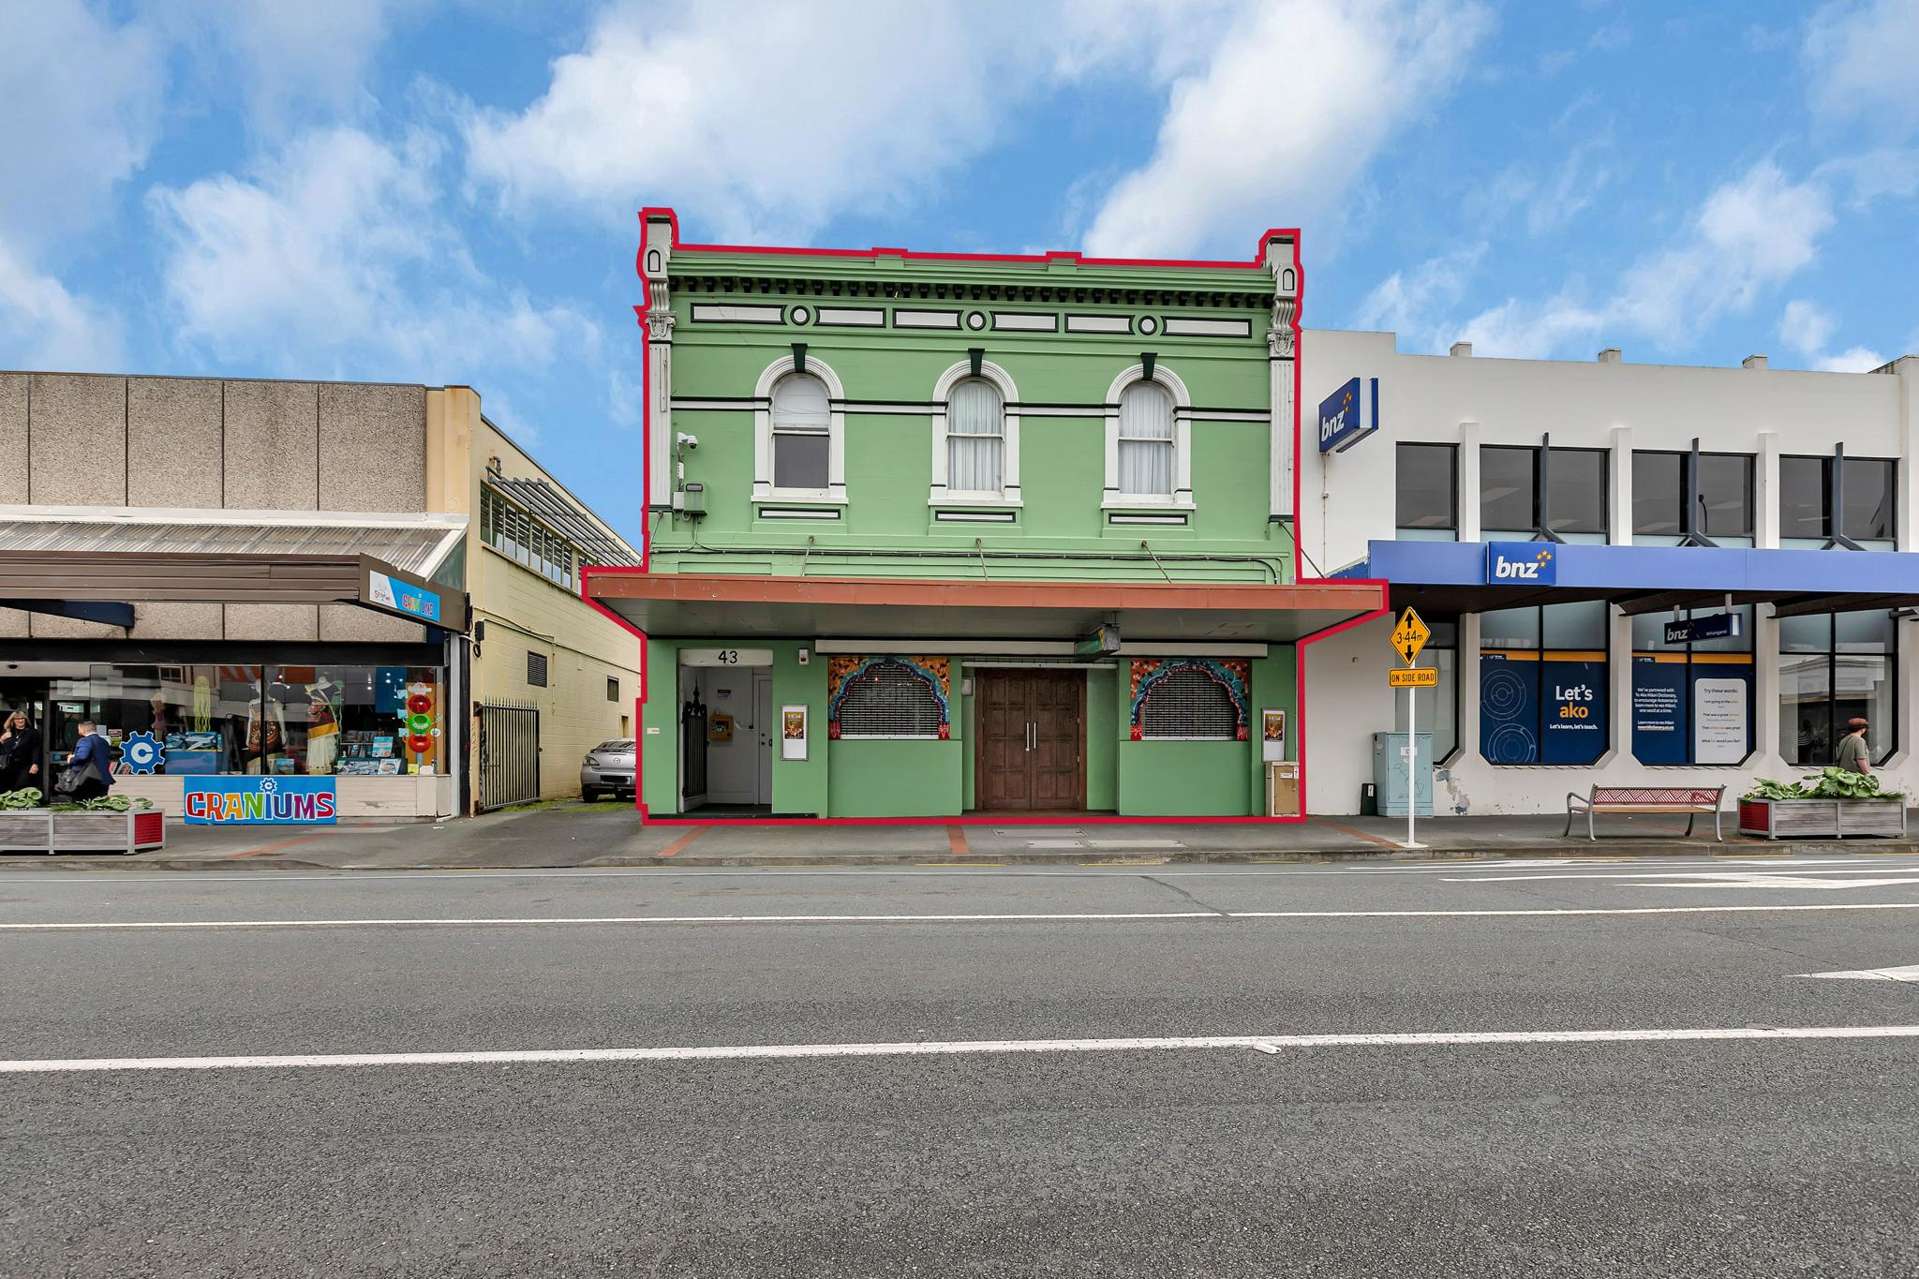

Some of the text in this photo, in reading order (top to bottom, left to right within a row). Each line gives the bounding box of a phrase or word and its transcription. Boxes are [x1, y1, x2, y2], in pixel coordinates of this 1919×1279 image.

[1321, 410, 1345, 442] bnz
[1496, 555, 1539, 578] bnz
[1667, 628, 1688, 641] bnz
[718, 650, 738, 664] 43
[1391, 672, 1435, 683] ON SIDE ROAD
[1555, 684, 1593, 701] Let's
[1559, 702, 1589, 719] ako
[186, 791, 335, 821] CRANIUMS
